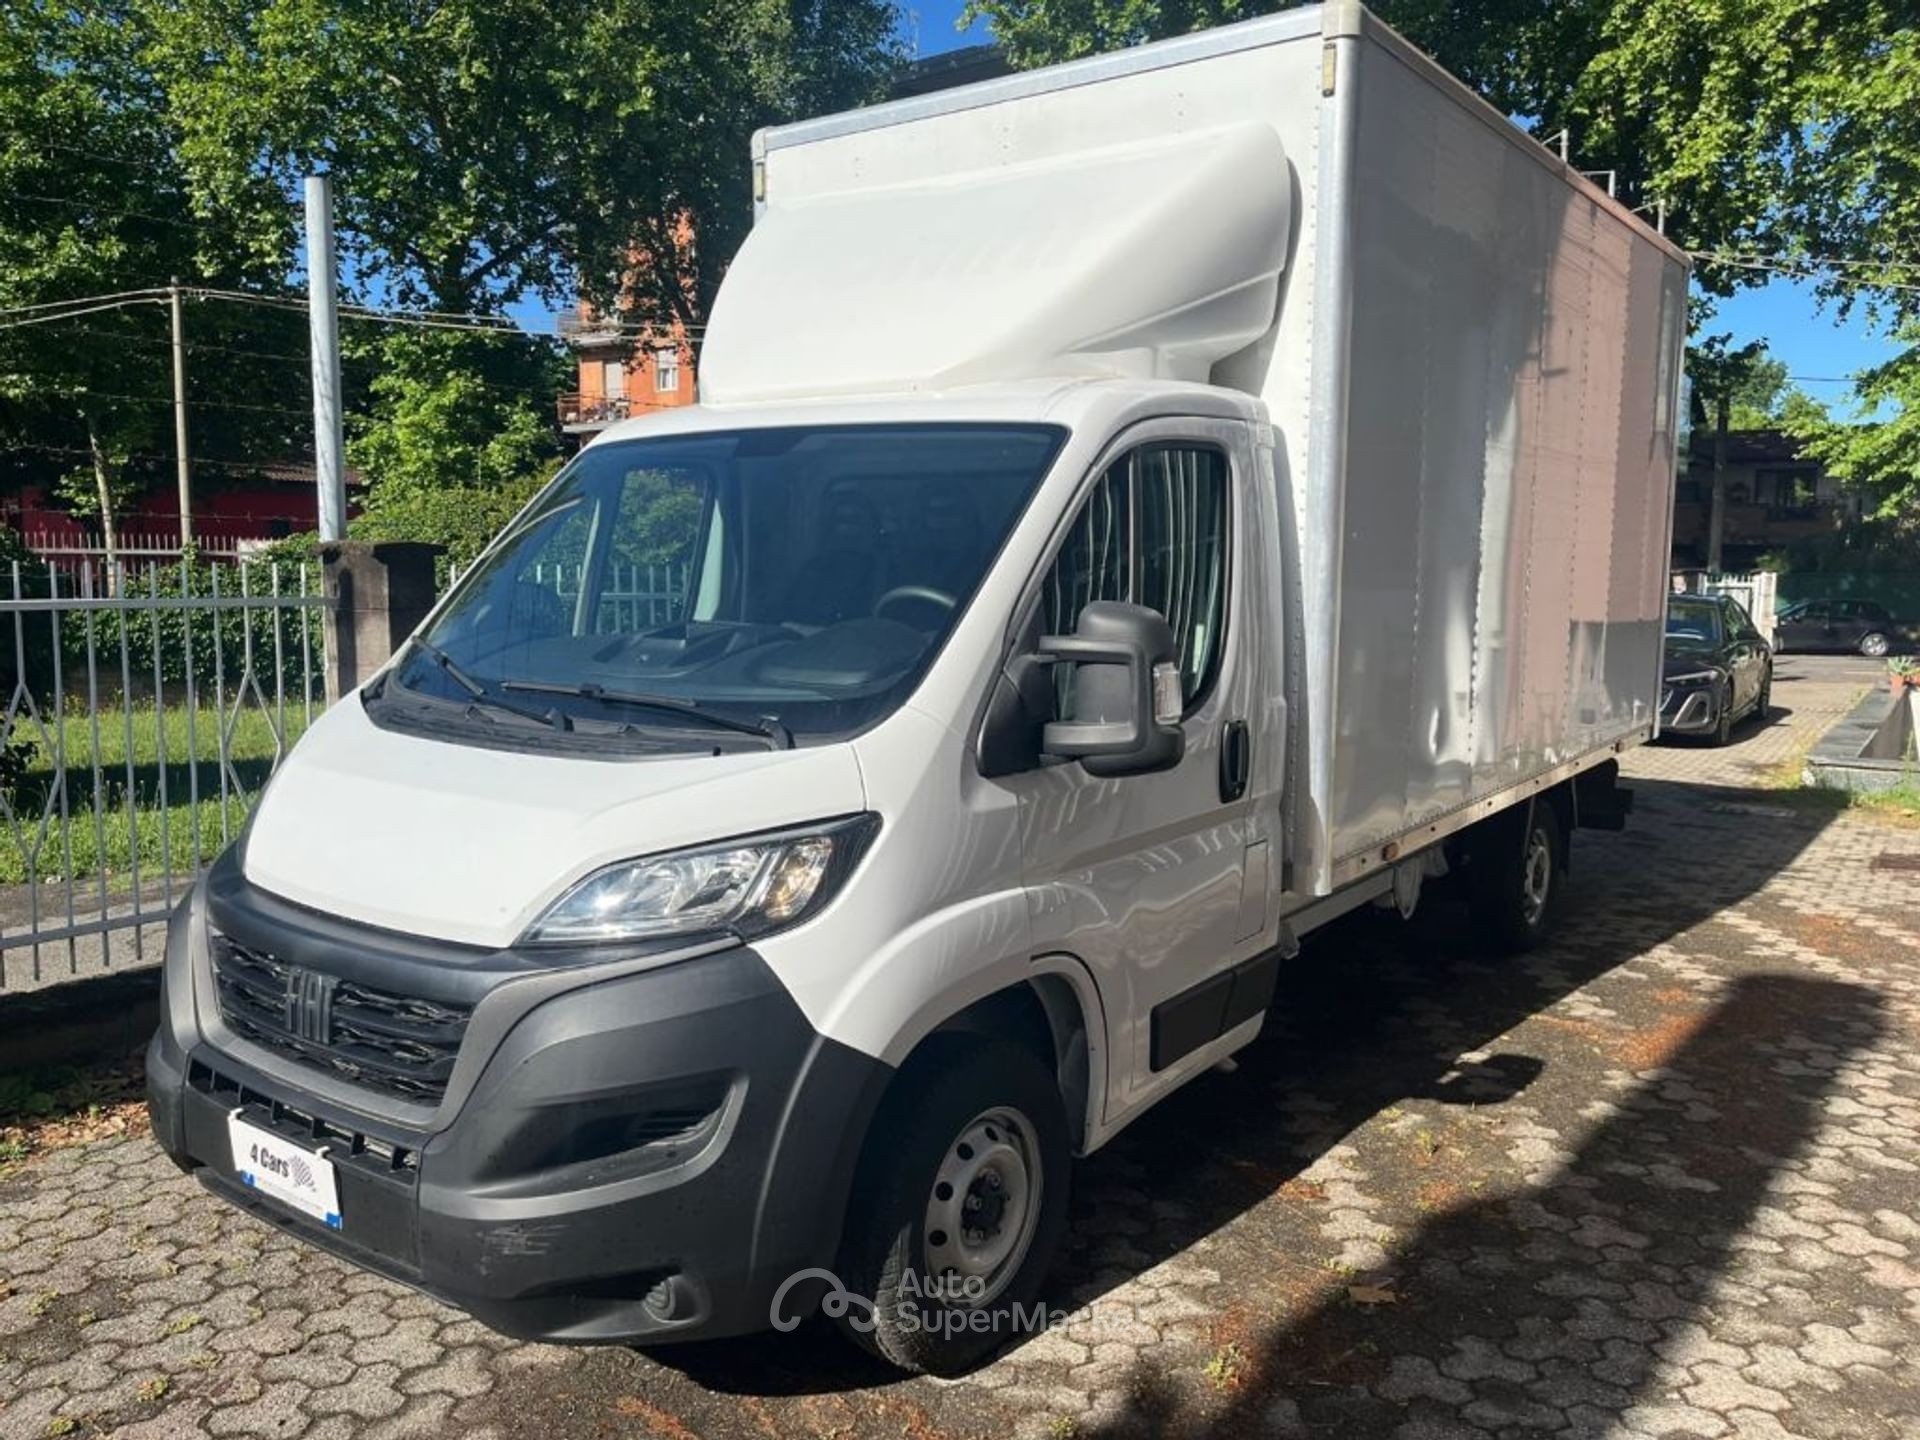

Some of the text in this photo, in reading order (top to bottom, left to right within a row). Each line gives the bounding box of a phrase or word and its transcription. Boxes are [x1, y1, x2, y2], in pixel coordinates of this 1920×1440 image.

[286, 967, 341, 1044] FIAT
[249, 1143, 290, 1178] 4 Cars
